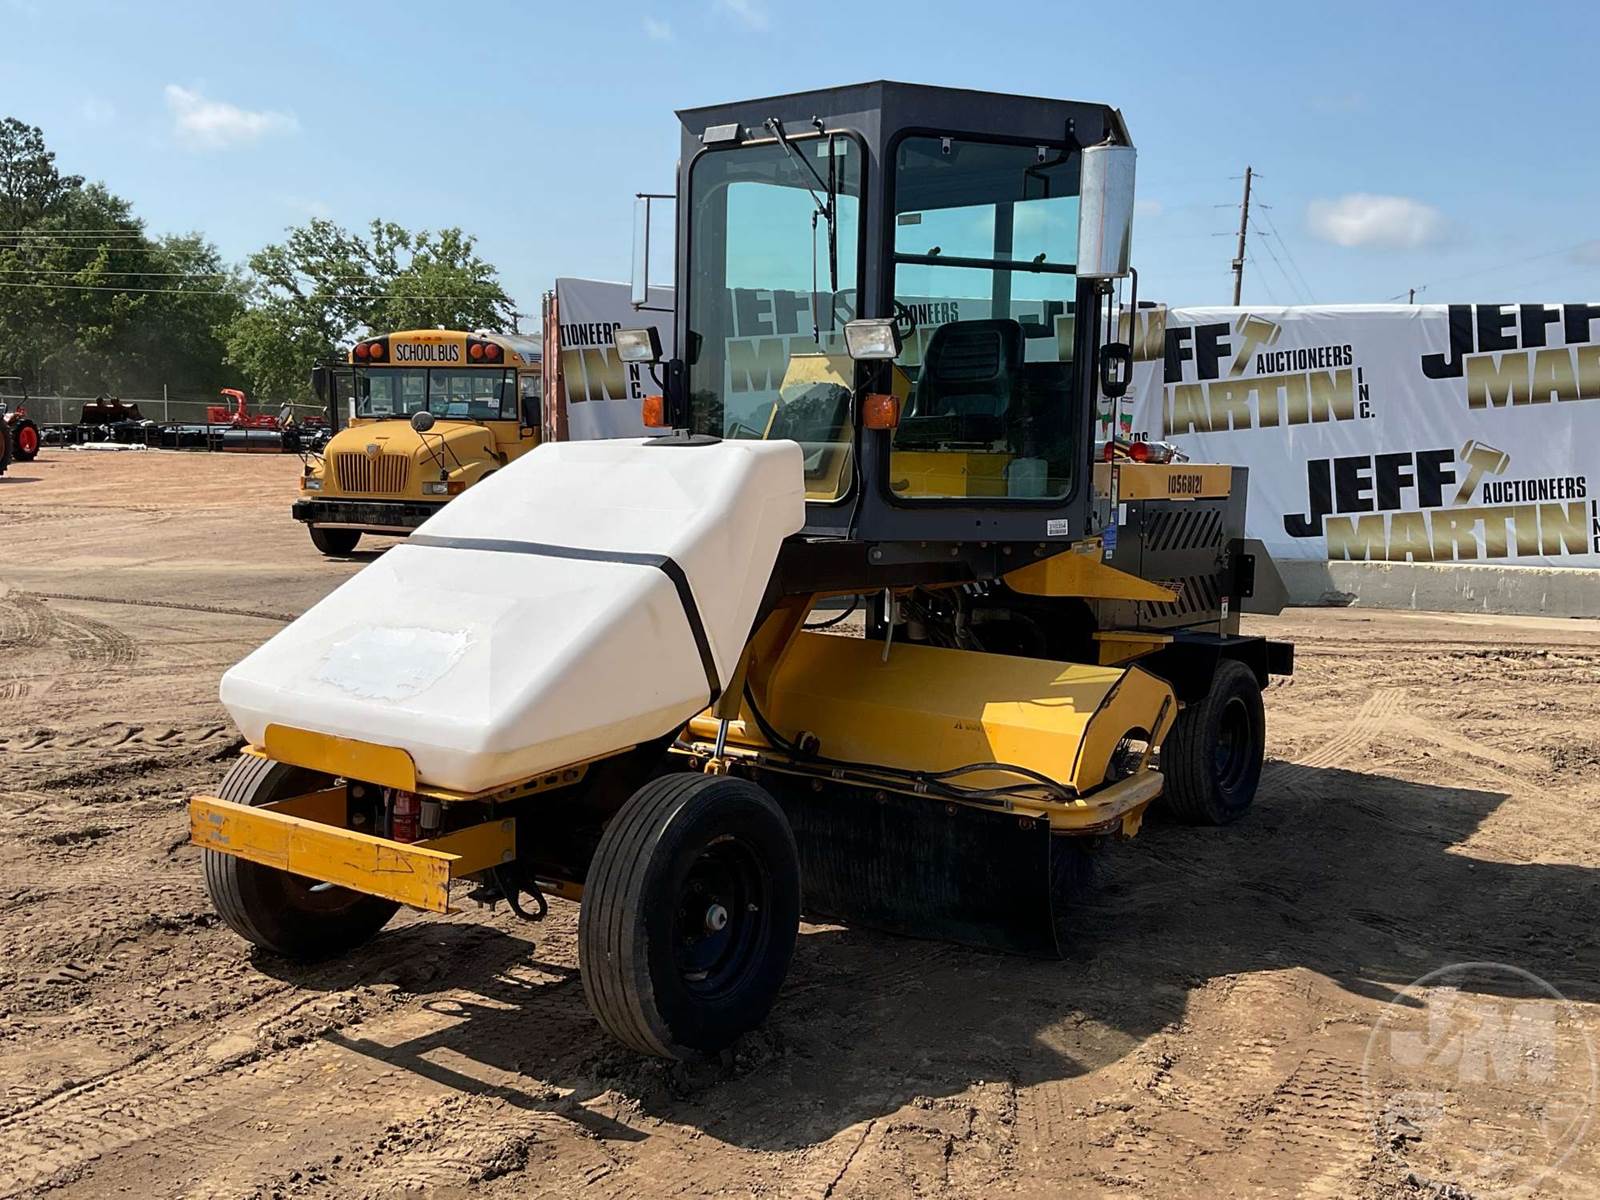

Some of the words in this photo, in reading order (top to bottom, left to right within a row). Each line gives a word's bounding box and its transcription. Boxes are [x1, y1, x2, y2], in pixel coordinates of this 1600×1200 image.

[396, 344, 437, 362] SCHOOL
[438, 344, 459, 362] BUS
[1256, 344, 1353, 375] AUCTIONEERS
[1163, 368, 1355, 436] ARTIN
[1283, 448, 1457, 538] JEFF
[1482, 476, 1587, 505] AUCTIONEERS
[1325, 501, 1589, 562] MARTIN
